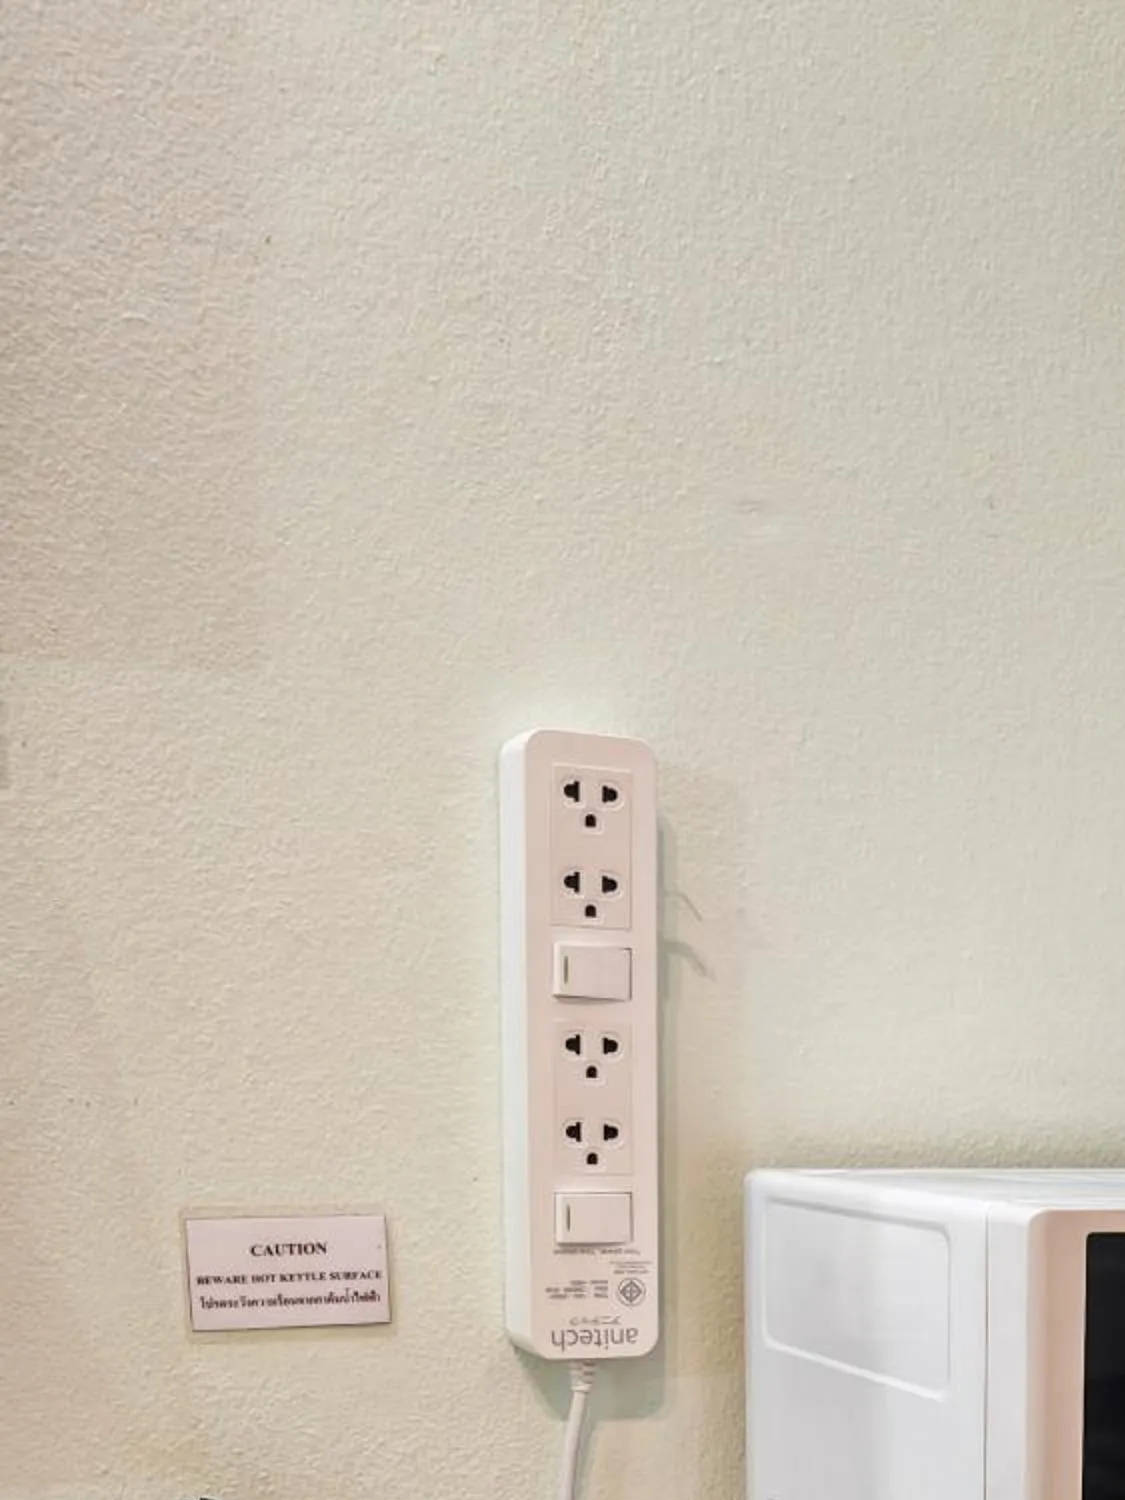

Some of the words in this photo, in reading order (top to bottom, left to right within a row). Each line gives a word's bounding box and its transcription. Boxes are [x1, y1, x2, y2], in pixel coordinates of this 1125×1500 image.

[250, 1241, 327, 1257] CAUTION
[197, 1273, 248, 1285] BEWARE
[252, 1272, 276, 1284] HOT
[279, 1271, 326, 1283] KETTLE
[329, 1269, 382, 1281] SURFACE
[551, 1327, 639, 1352] anitech
